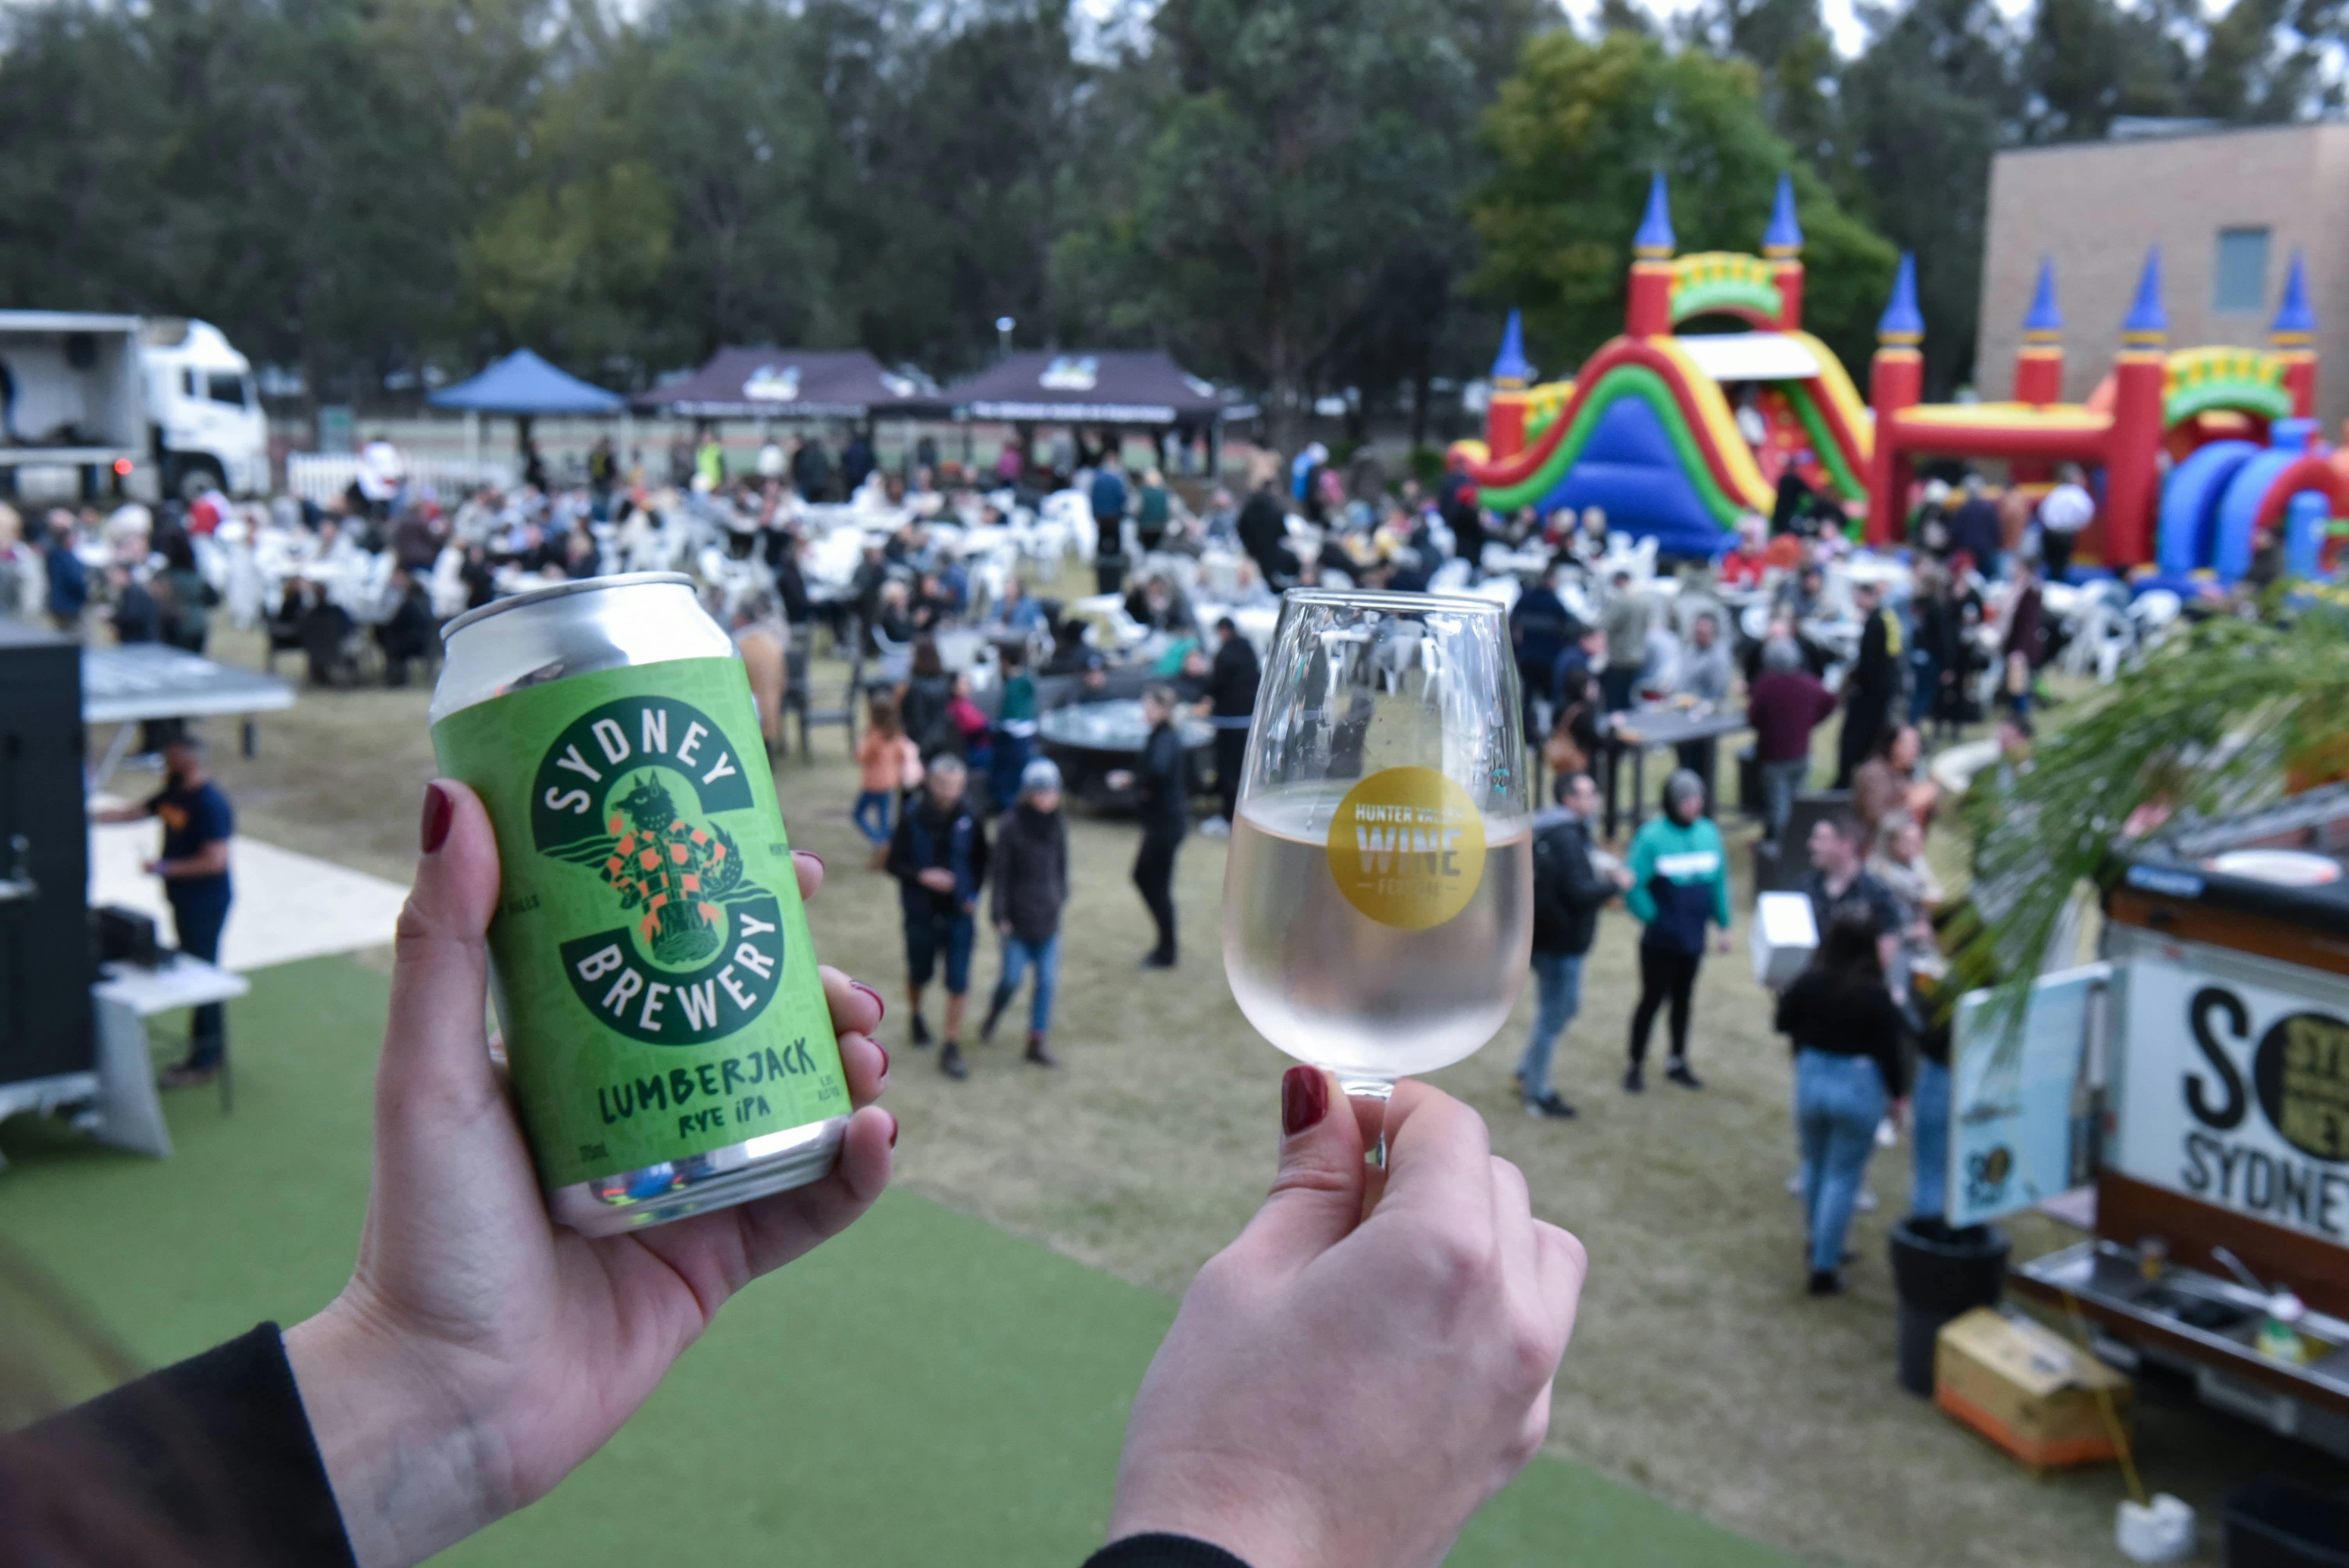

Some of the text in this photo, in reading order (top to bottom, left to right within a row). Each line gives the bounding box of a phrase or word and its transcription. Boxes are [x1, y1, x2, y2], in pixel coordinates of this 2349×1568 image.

[545, 709, 736, 814] SYDNEY
[1355, 803, 1412, 823] HUNTER
[1356, 824, 1463, 877] WINE
[577, 913, 776, 1032] BREWERY
[597, 1037, 816, 1125] LUMBERJACK
[679, 1107, 725, 1139] RYE
